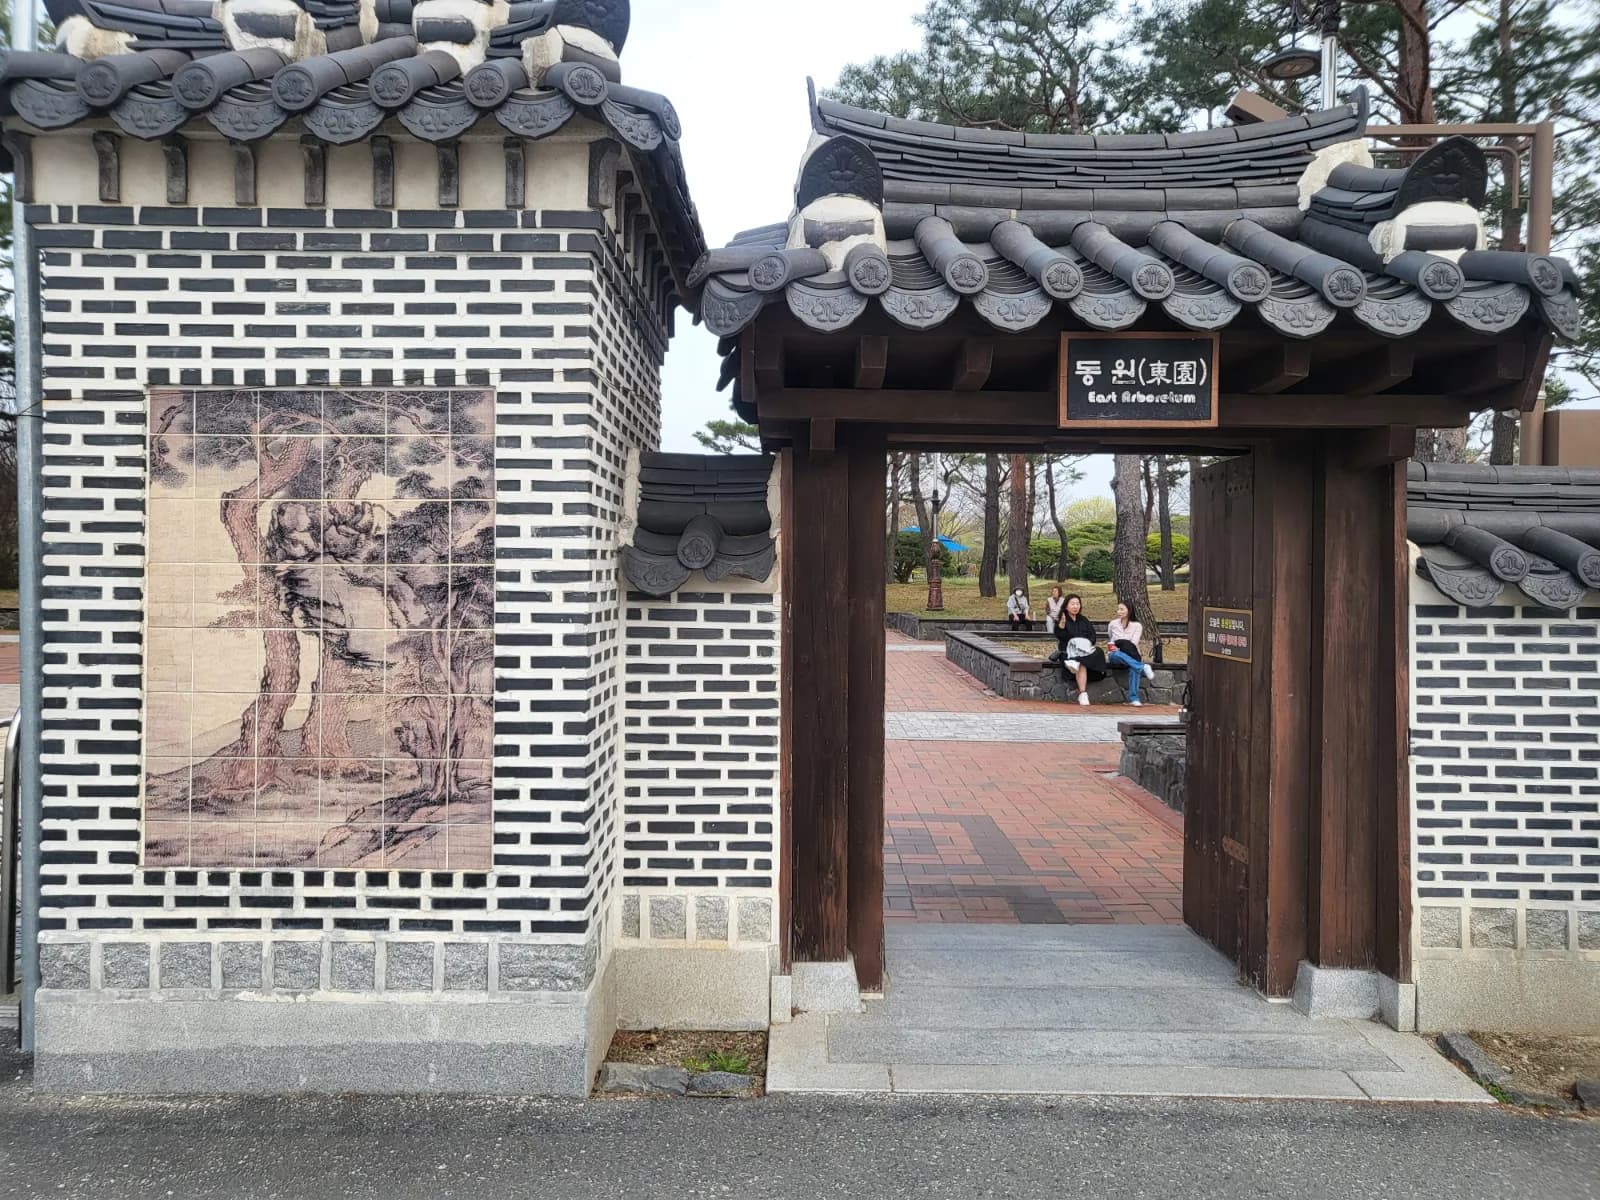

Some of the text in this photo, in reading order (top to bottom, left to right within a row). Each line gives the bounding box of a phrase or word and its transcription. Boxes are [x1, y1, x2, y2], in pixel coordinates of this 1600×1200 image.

[1074, 360, 1102, 386] 동
[1087, 391, 1196, 404] East Arboretum
